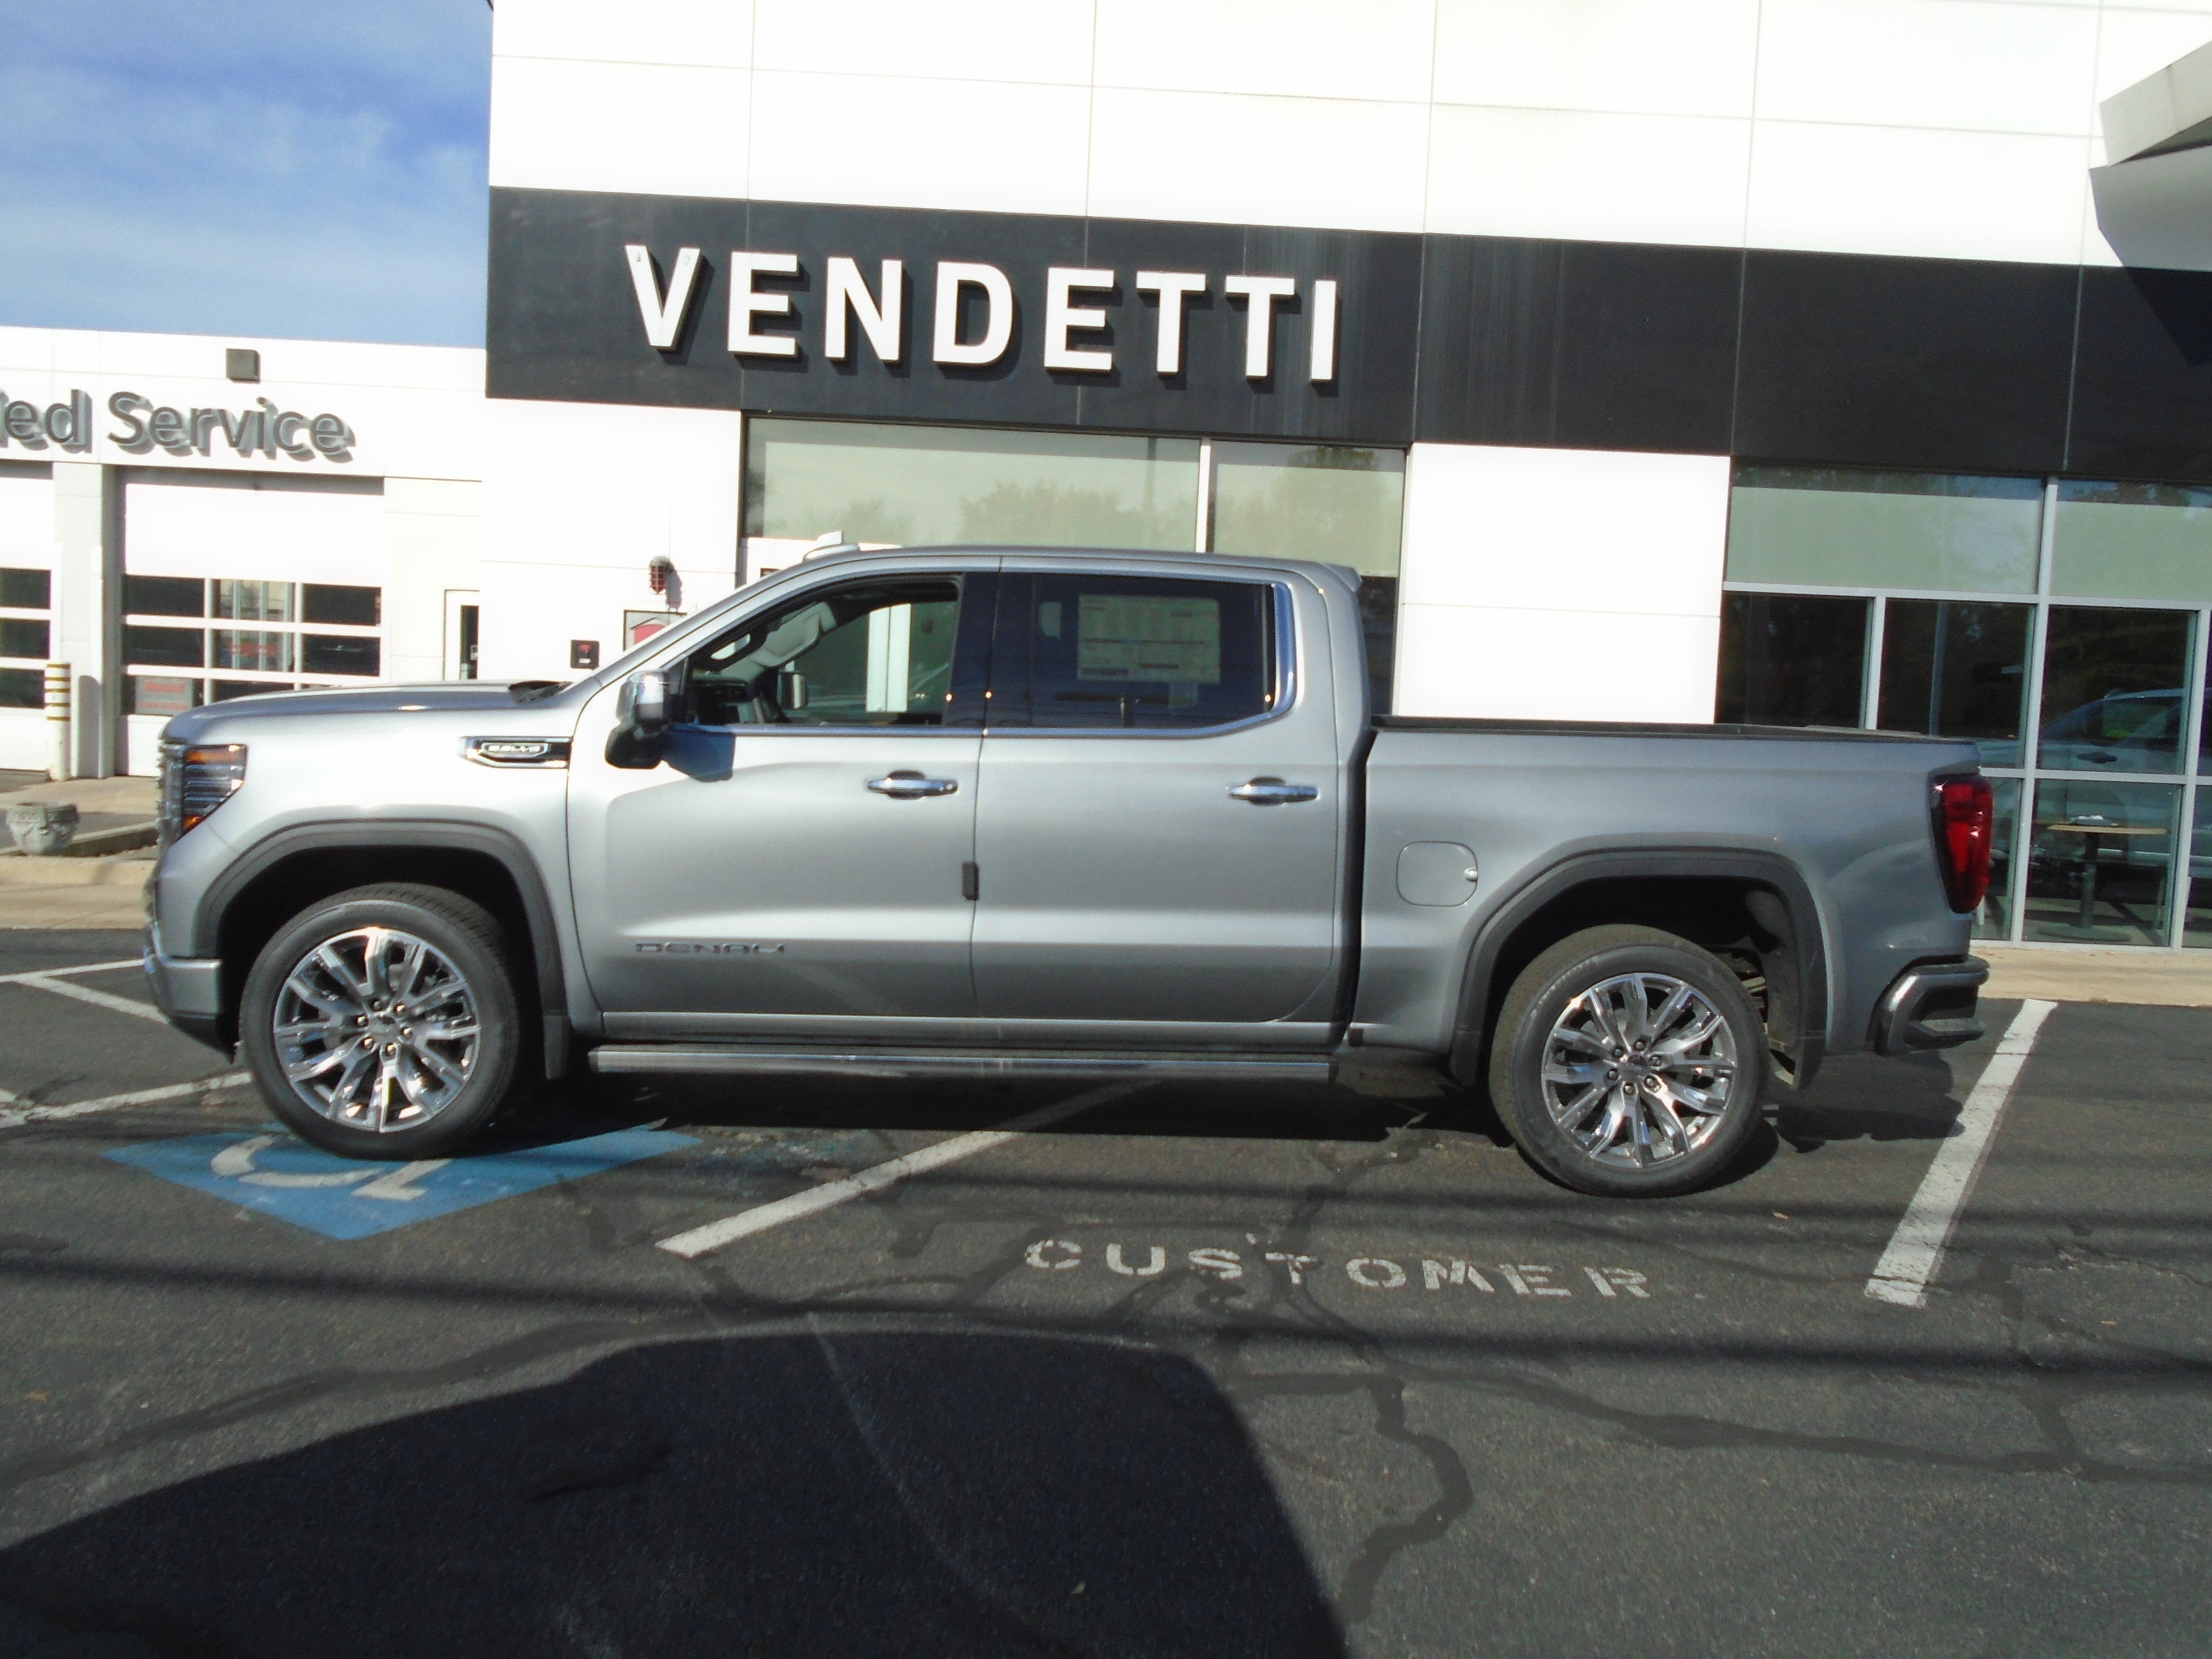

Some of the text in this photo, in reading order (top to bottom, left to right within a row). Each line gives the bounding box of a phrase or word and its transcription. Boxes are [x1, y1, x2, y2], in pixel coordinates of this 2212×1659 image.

[625, 244, 1337, 382] VENDETTI
[0, 389, 354, 461] ed Service
[635, 941, 785, 954] DENALI
[1024, 1239, 1651, 1298] CUSTOMER
